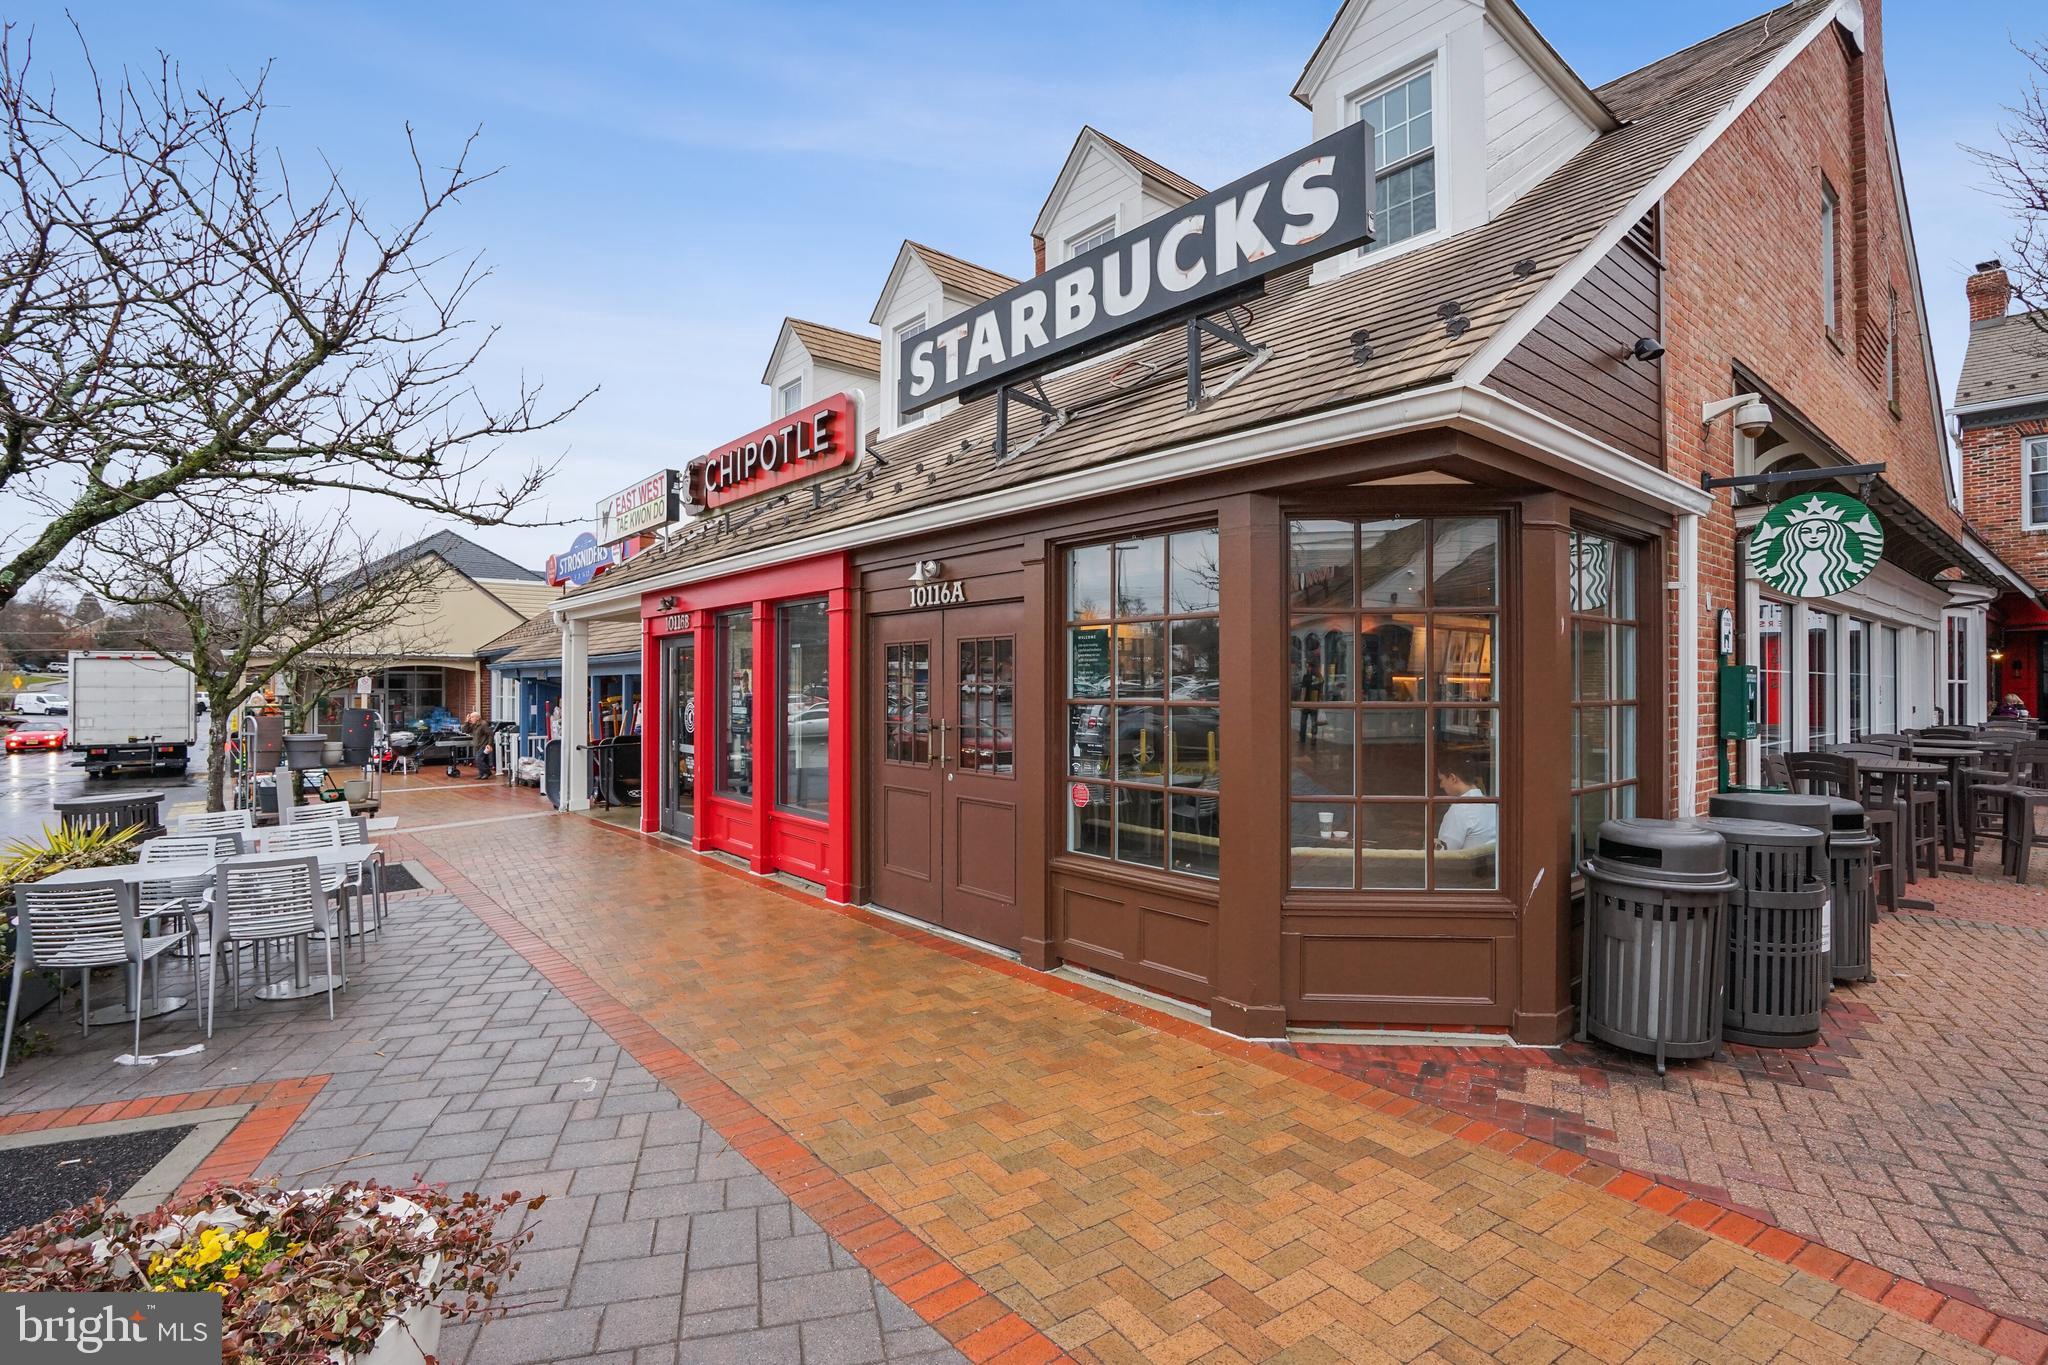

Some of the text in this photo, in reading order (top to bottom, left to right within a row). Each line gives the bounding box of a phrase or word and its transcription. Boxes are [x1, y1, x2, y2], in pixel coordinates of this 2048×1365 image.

[909, 155, 1340, 397] STARBUCKS
[705, 409, 832, 491] CHIPOTLE
[616, 475, 665, 517] EAST WEST
[617, 499, 665, 533] TAE KWON DO
[910, 581, 965, 607] 10116A
